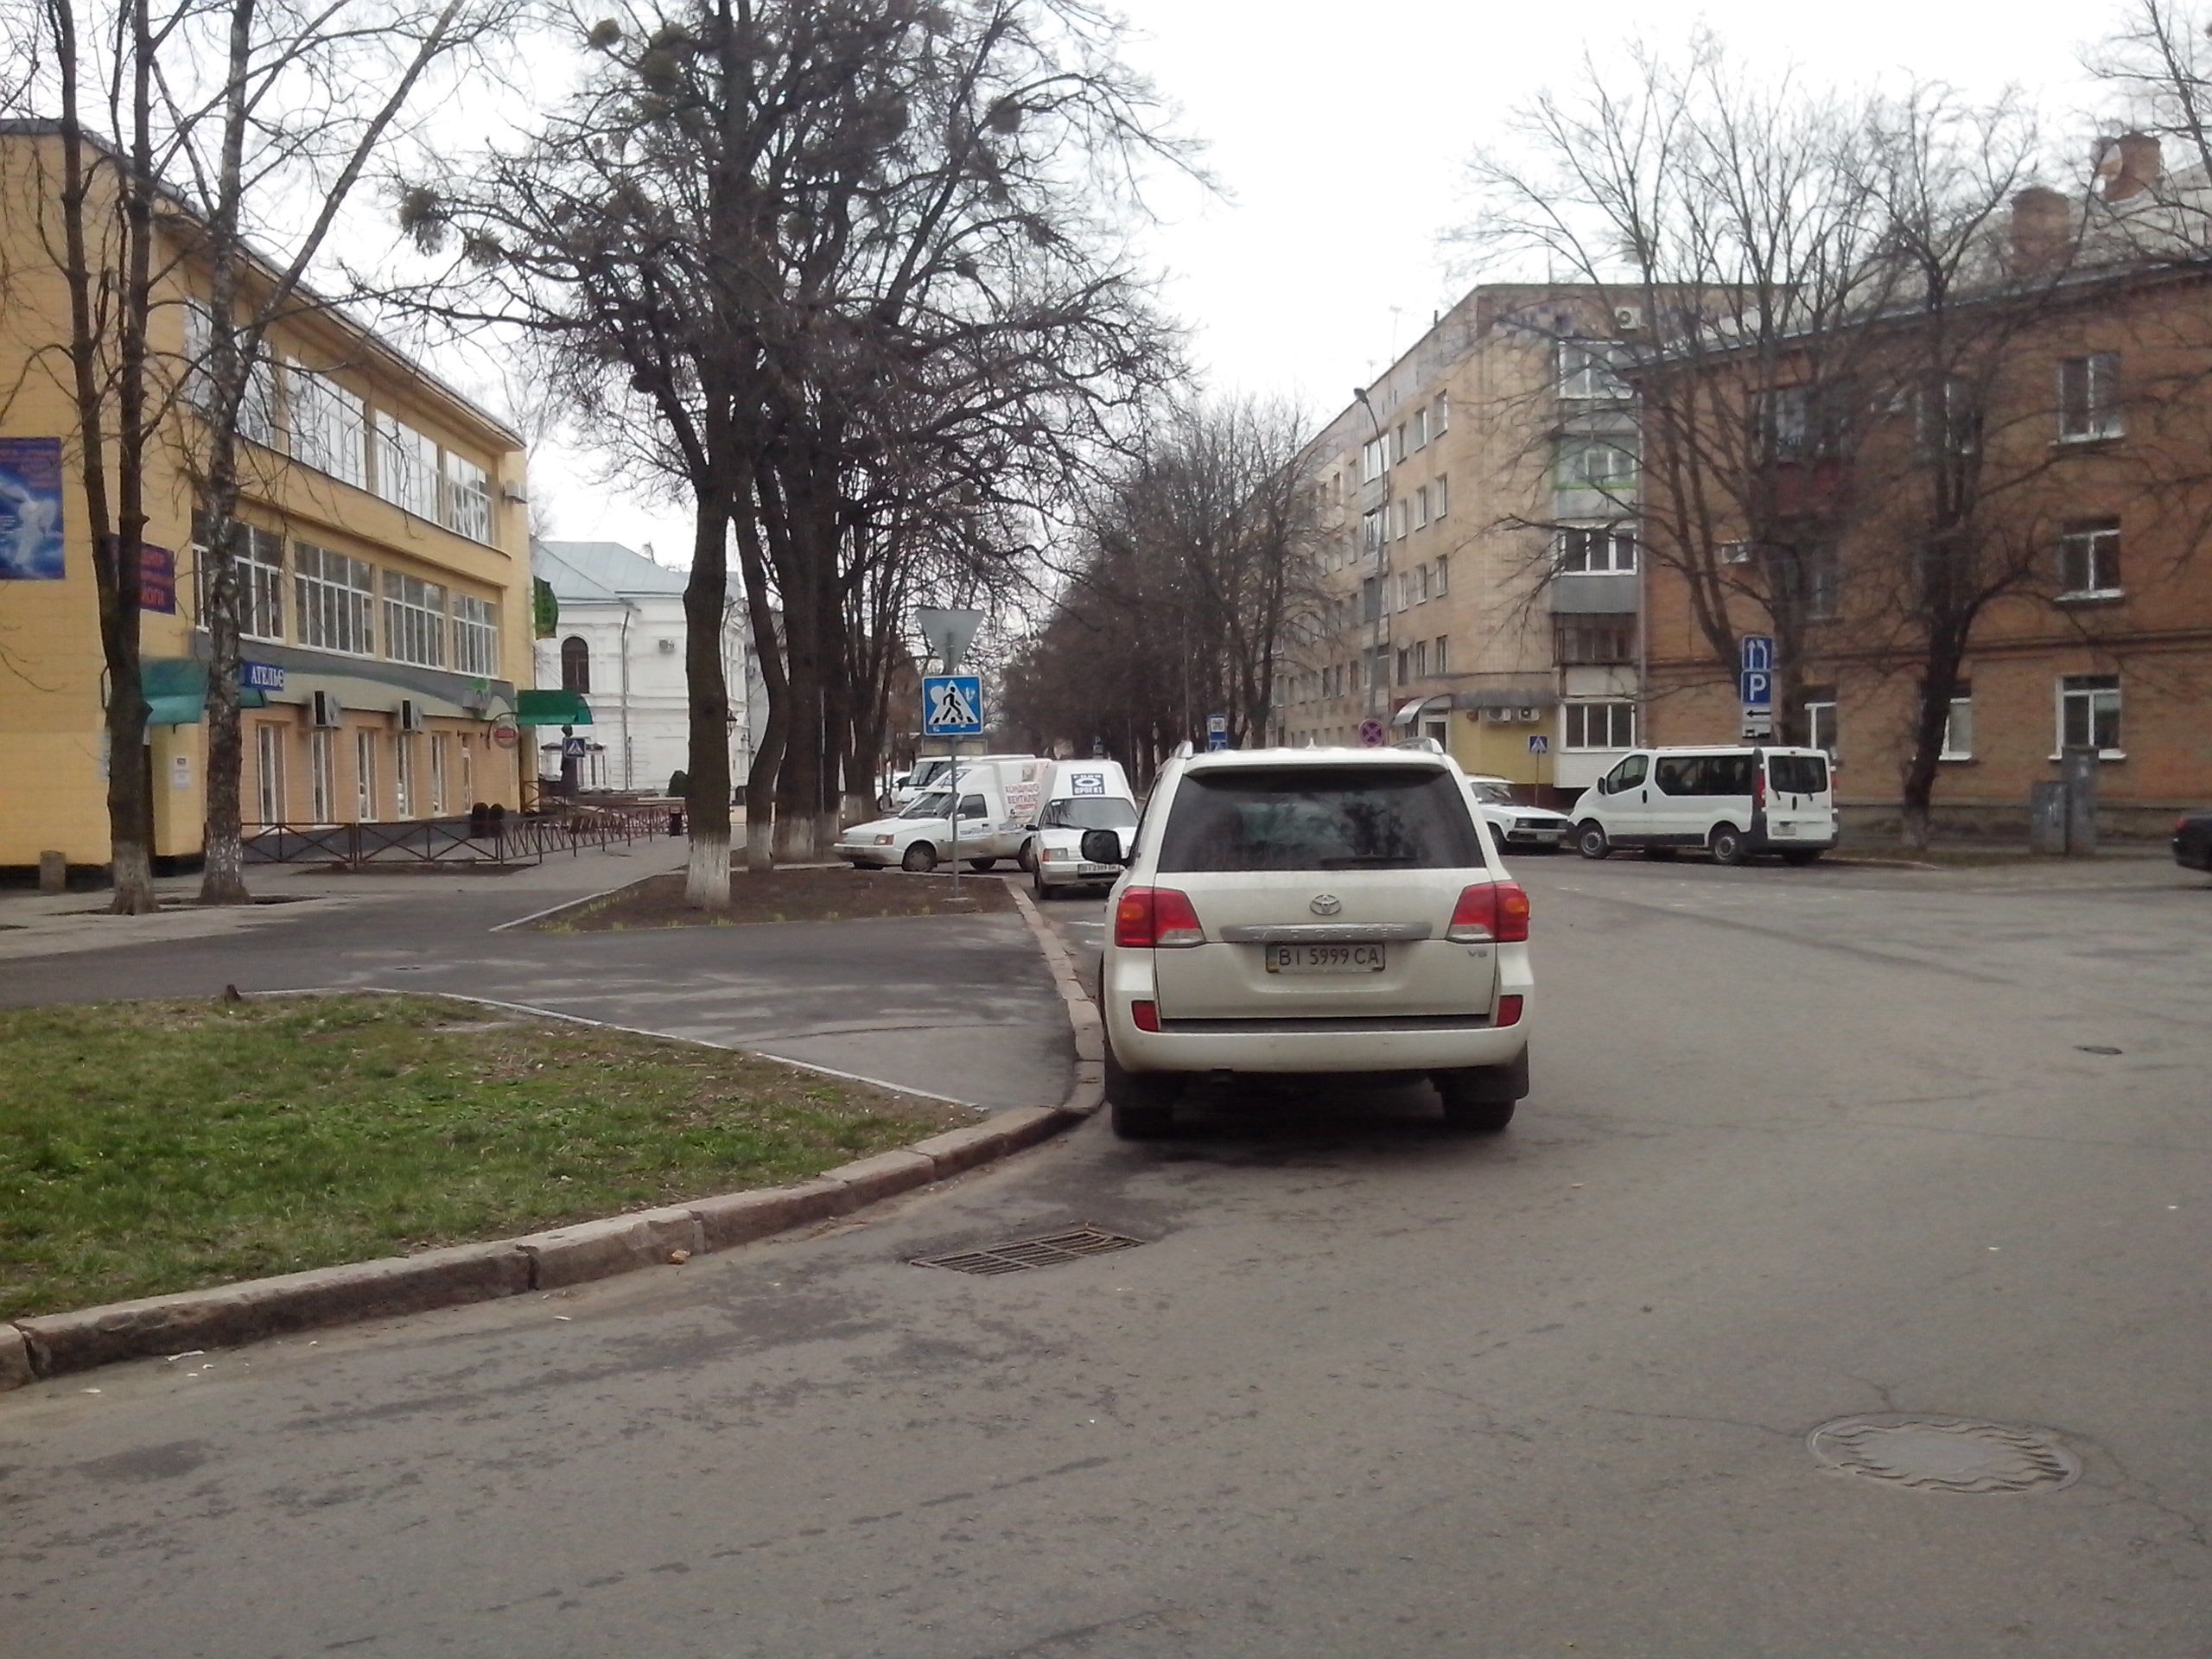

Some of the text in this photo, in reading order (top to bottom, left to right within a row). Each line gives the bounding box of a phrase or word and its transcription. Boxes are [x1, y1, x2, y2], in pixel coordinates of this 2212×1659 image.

[1749, 673, 1766, 702] P
[1278, 947, 1379, 966] BI 5999 CA
